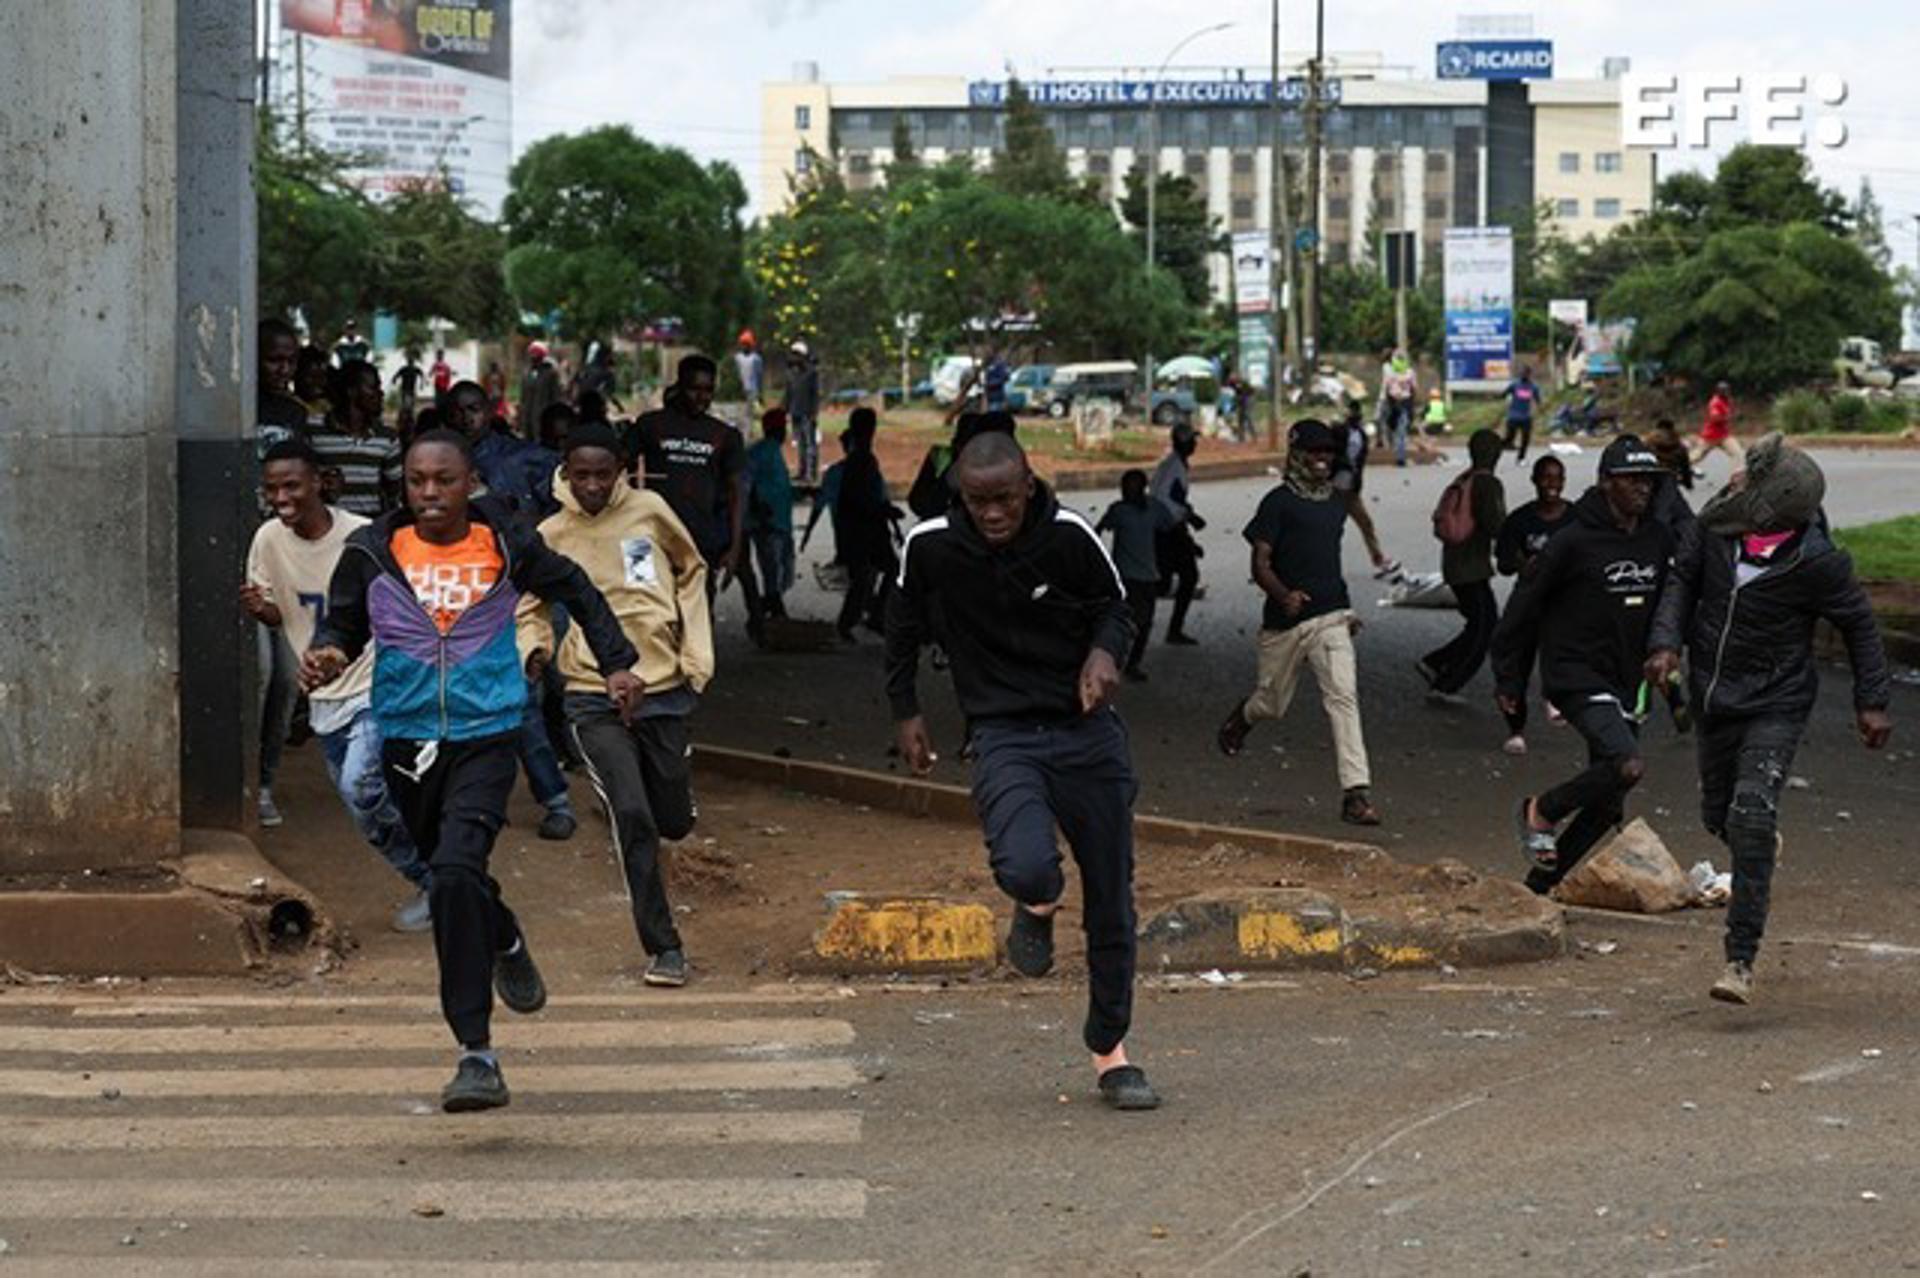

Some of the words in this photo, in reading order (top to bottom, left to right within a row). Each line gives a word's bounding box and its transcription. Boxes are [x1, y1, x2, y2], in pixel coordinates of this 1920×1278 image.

[1474, 50, 1551, 69] RCMRD
[1050, 84, 1128, 101] HOSTEL
[1132, 84, 1149, 101] &
[1153, 83, 1267, 101] EXECUTIVE
[660, 438, 714, 454] verizon
[405, 563, 486, 588] HOT
